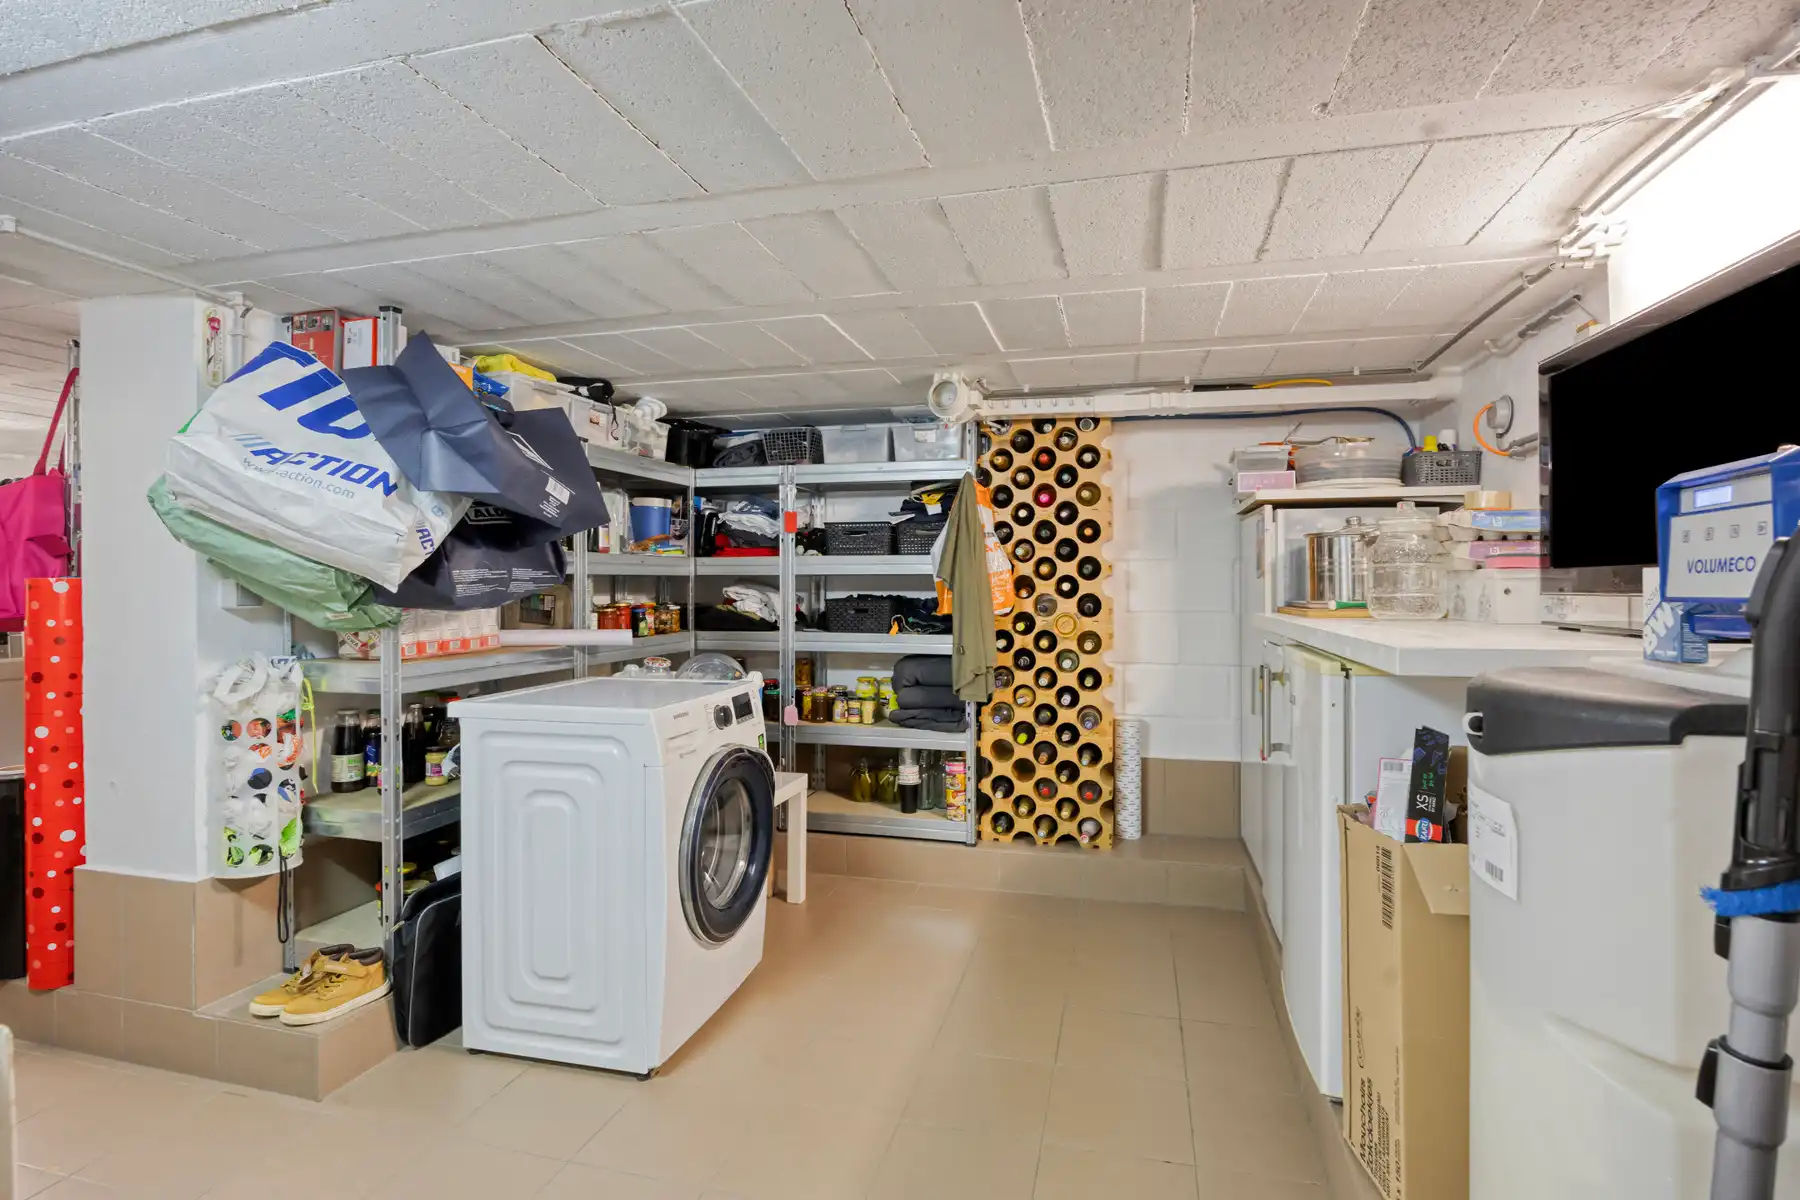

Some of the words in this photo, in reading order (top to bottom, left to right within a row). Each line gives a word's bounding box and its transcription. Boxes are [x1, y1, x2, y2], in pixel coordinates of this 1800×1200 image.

[250, 447, 399, 497] ACTION
[1687, 556, 1757, 574] VOLUMECO
[1415, 794, 1429, 811] XS
